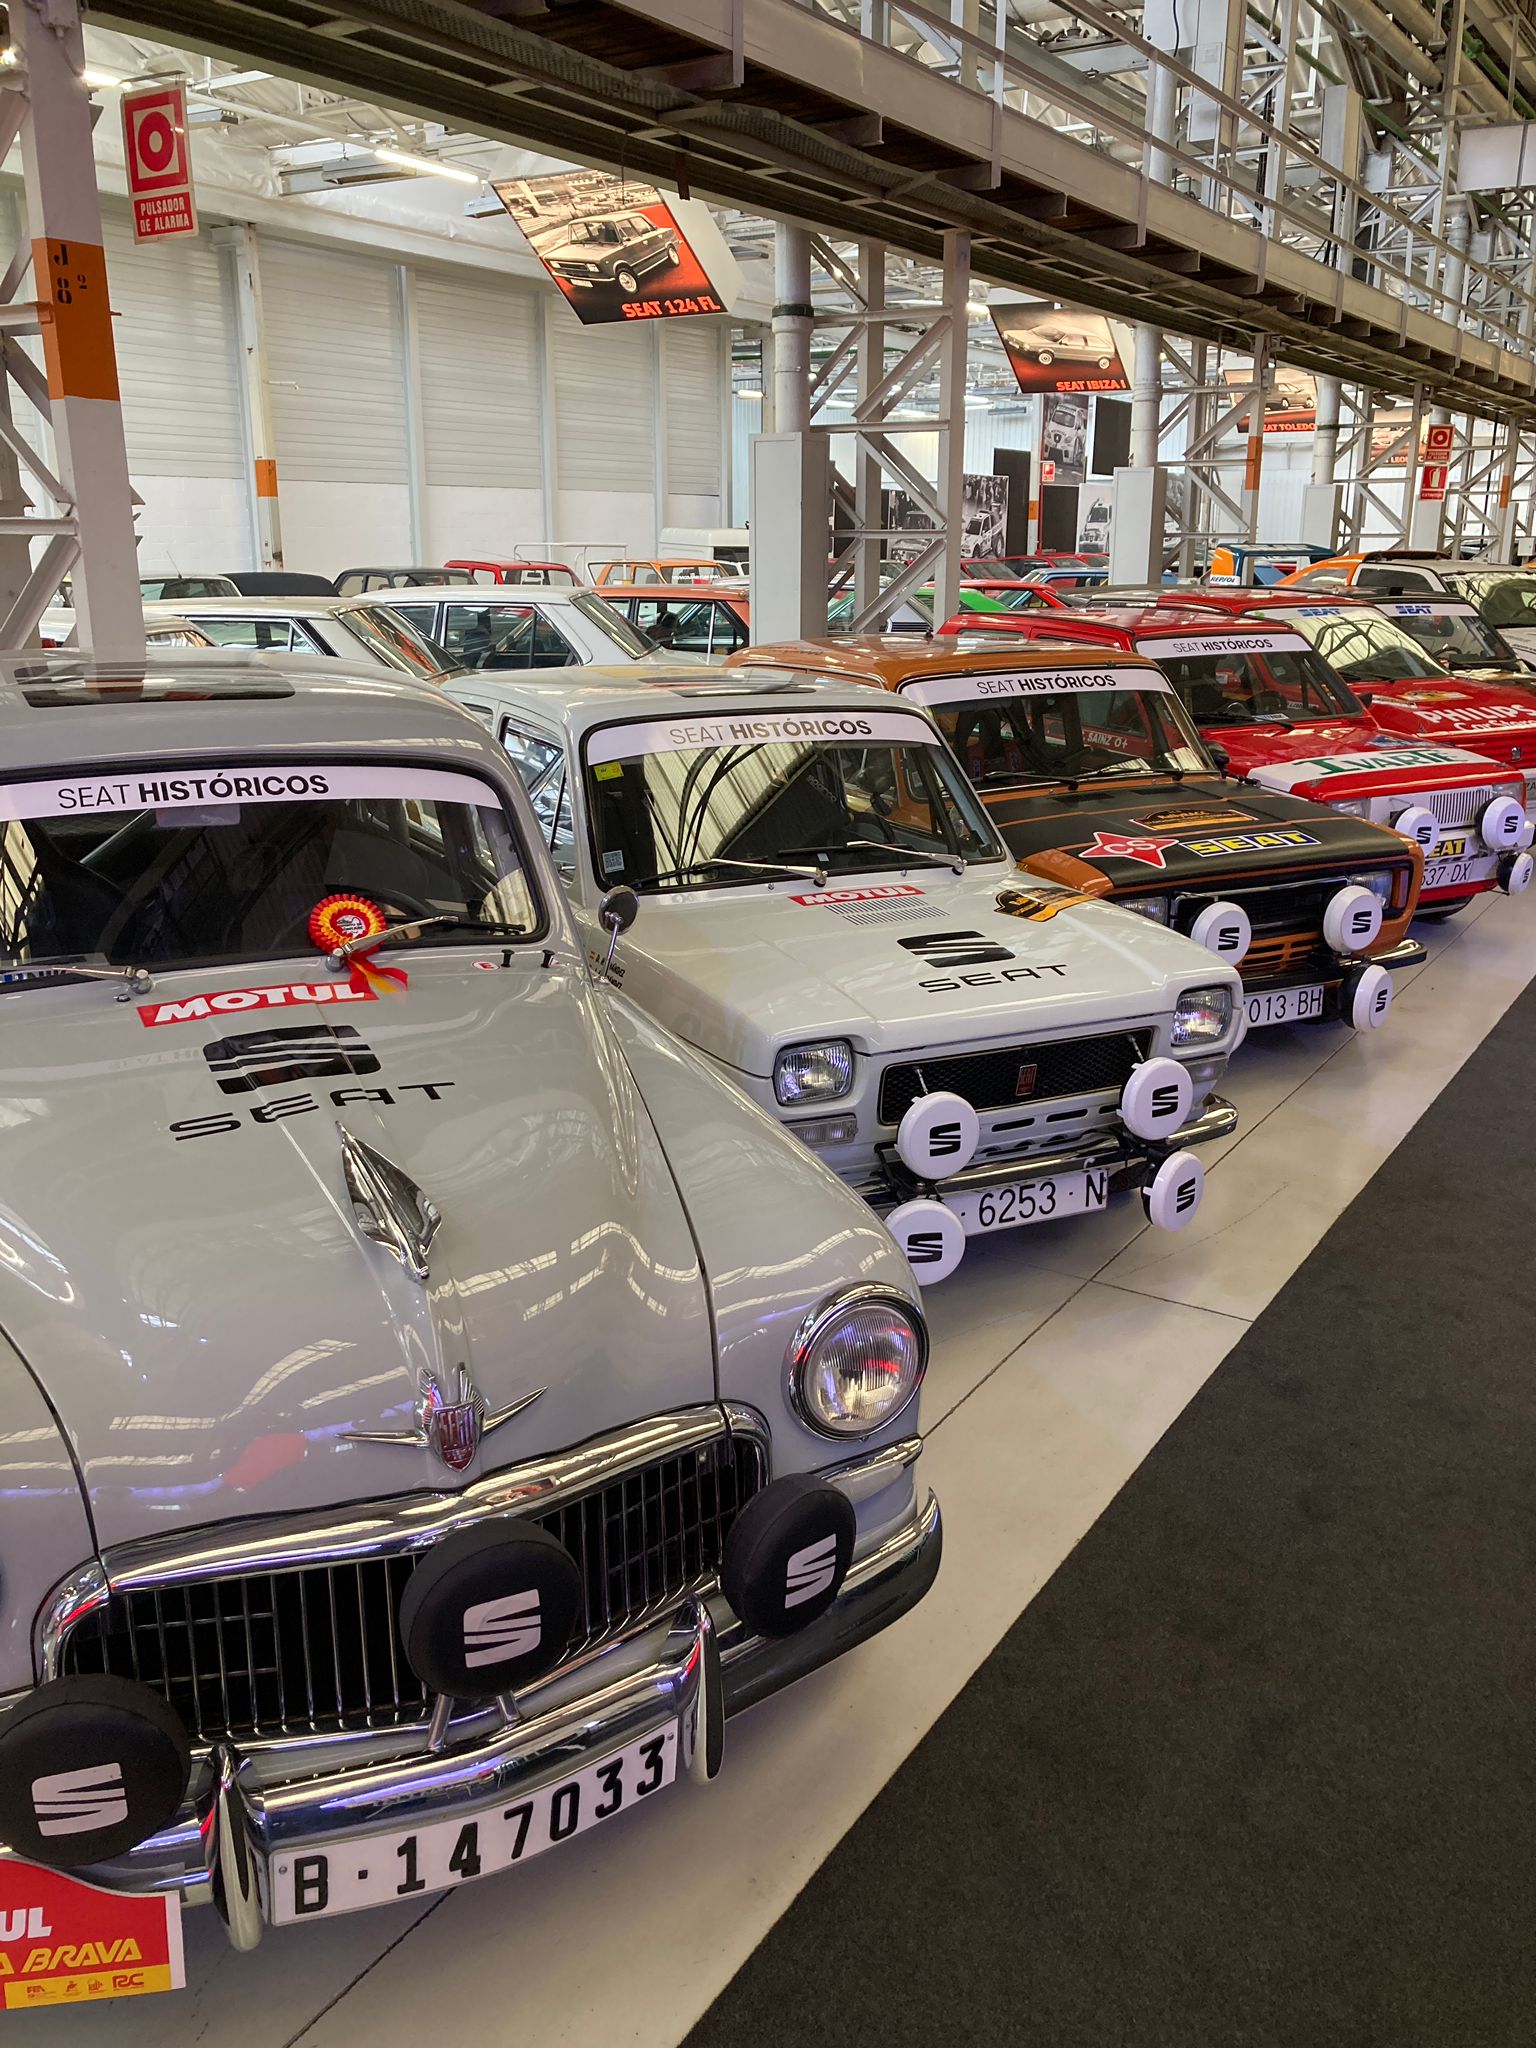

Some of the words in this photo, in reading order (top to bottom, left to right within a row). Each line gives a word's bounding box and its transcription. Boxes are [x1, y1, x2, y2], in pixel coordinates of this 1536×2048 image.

[140, 197, 185, 216] PULSADOR
[140, 218, 151, 233] DE
[154, 213, 190, 231] ALARMA
[53, 244, 68, 266] J
[57, 277, 72, 305] 8
[621, 301, 663, 318] SEAT
[664, 298, 699, 314] 124
[697, 296, 721, 311] FL
[1056, 380, 1085, 391] SEAT
[1087, 380, 1119, 390] IBIZA
[1278, 423, 1317, 431] TOLEDO
[1210, 576, 1235, 584] REPSOL
[1298, 607, 1341, 617] SEAT
[1396, 605, 1432, 614] SEAT
[1173, 642, 1200, 653] SEAT
[1202, 638, 1273, 651] HISTÓRICOS
[977, 679, 1015, 694] SEAT
[1017, 673, 1117, 691] HISTÓRICOS
[1413, 704, 1536, 723] PHILIPS
[670, 724, 723, 745] SEAT
[729, 718, 872, 741] HISTÓRICOS
[1087, 732, 1112, 746] SAINZ
[58, 783, 130, 810] SEAT
[138, 772, 329, 803] HISTÓRICOS
[1104, 840, 1156, 854] CS
[1189, 833, 1303, 854] SEAT
[1429, 839, 1465, 857] EAT
[803, 886, 911, 905] MOTUL
[918, 963, 1067, 993] SEAT
[155, 983, 366, 1021] MOTUL
[169, 1081, 456, 1141] SEAT
[21, 1938, 142, 1973] BRAVA
